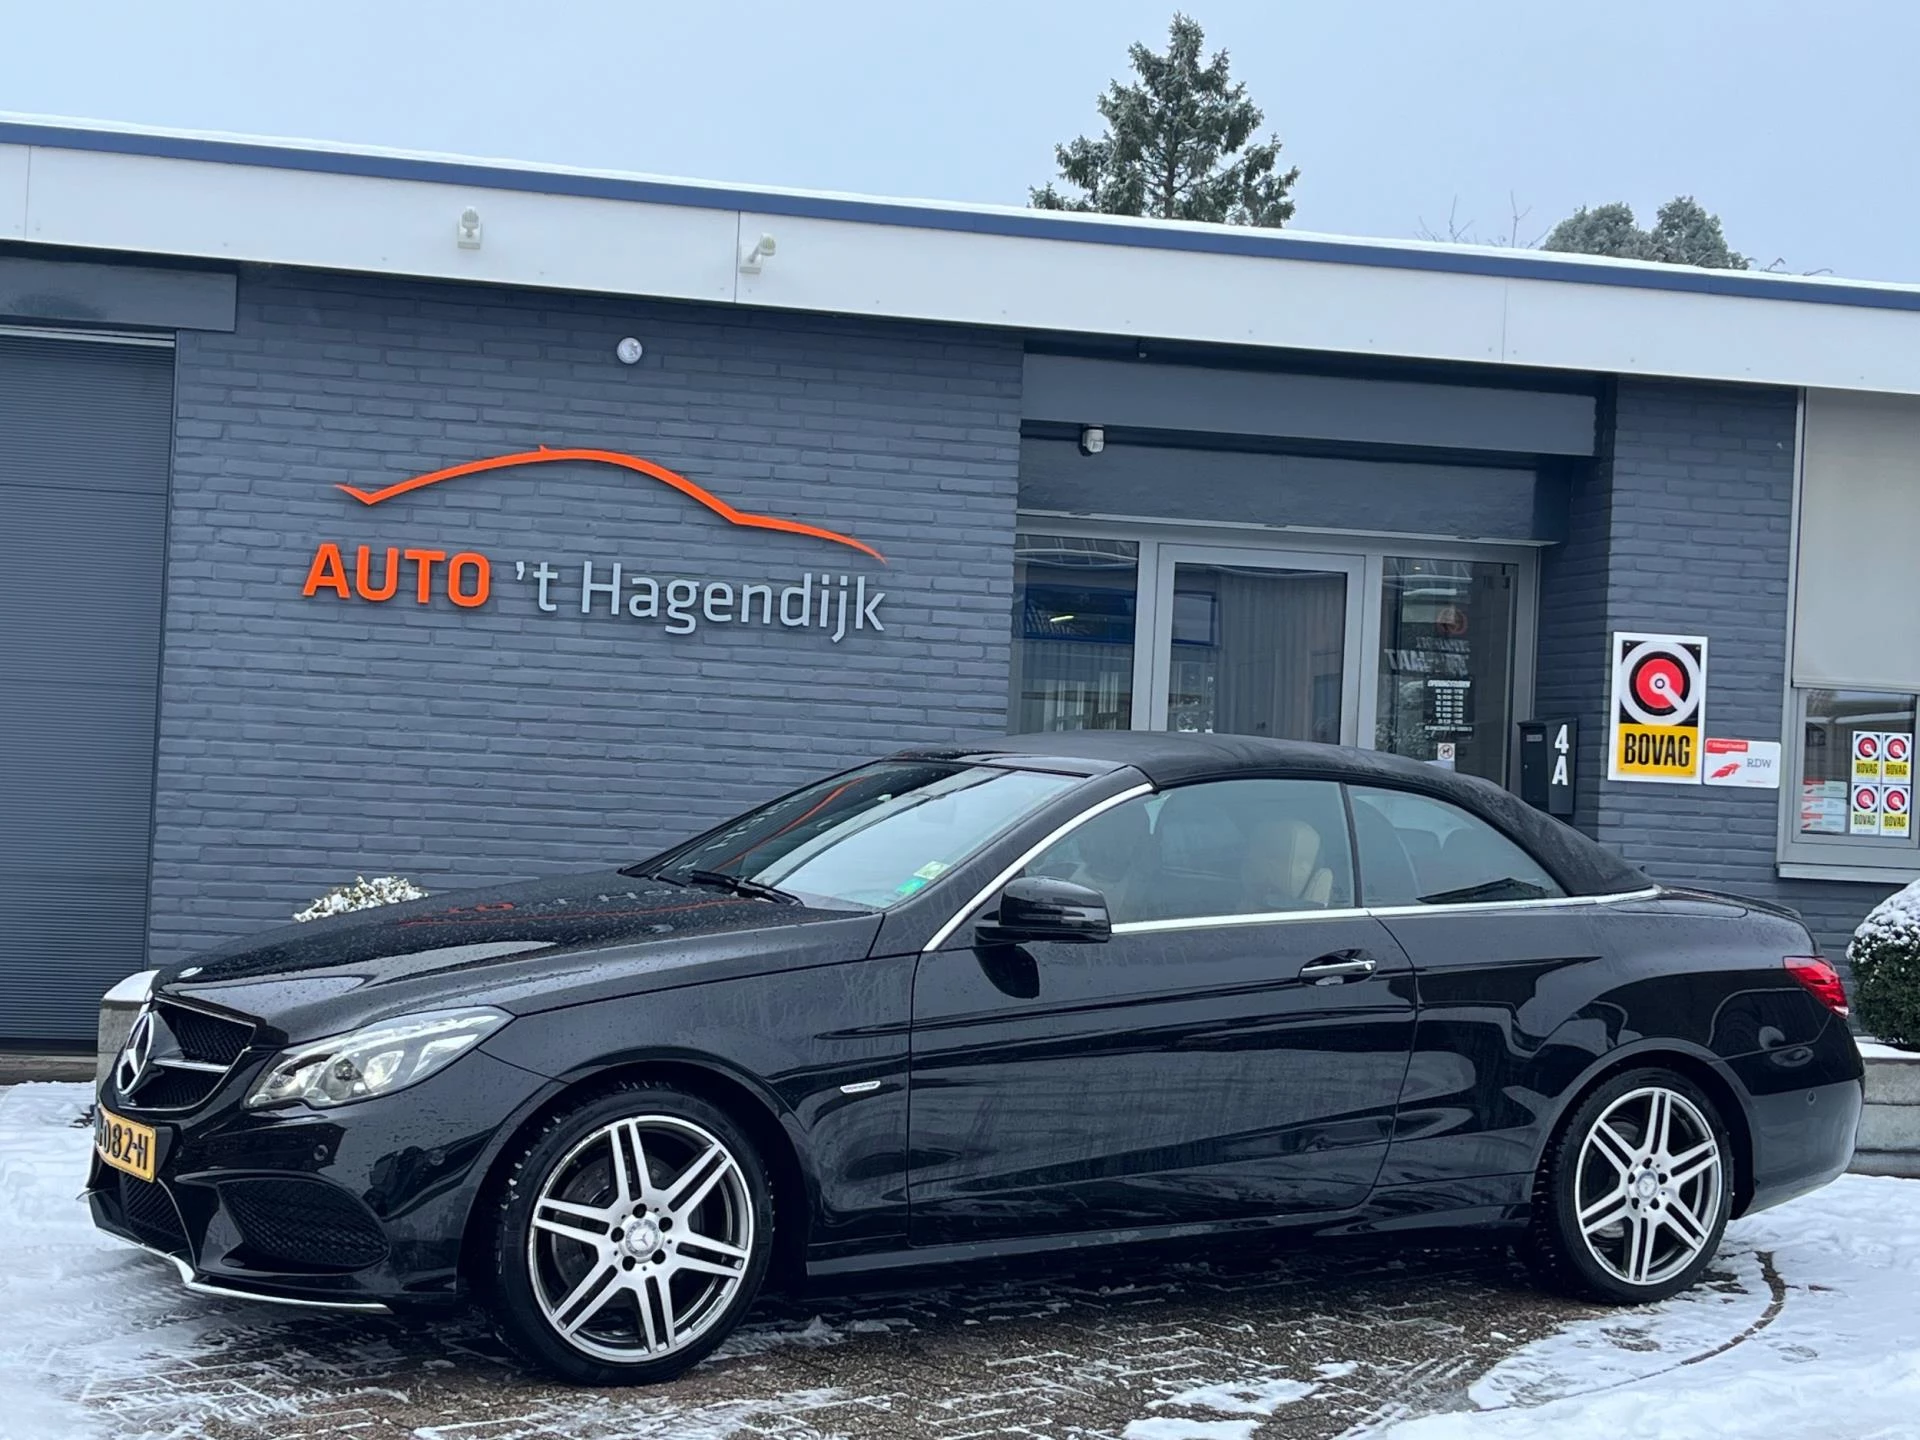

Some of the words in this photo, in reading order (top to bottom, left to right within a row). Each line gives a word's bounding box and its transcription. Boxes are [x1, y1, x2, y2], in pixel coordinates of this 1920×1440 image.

[302, 543, 491, 607] AUTO
[581, 560, 886, 643] Hagendijk
[1554, 724, 1569, 754] 4
[1624, 732, 1691, 768] BOVAG
[1747, 758, 1772, 769] RDW
[1855, 762, 1878, 775] BOVAG
[1885, 763, 1908, 776] BOVAG
[1552, 755, 1568, 786] A
[1853, 813, 1876, 826] BOVAG
[1883, 815, 1906, 828] BOVAG
